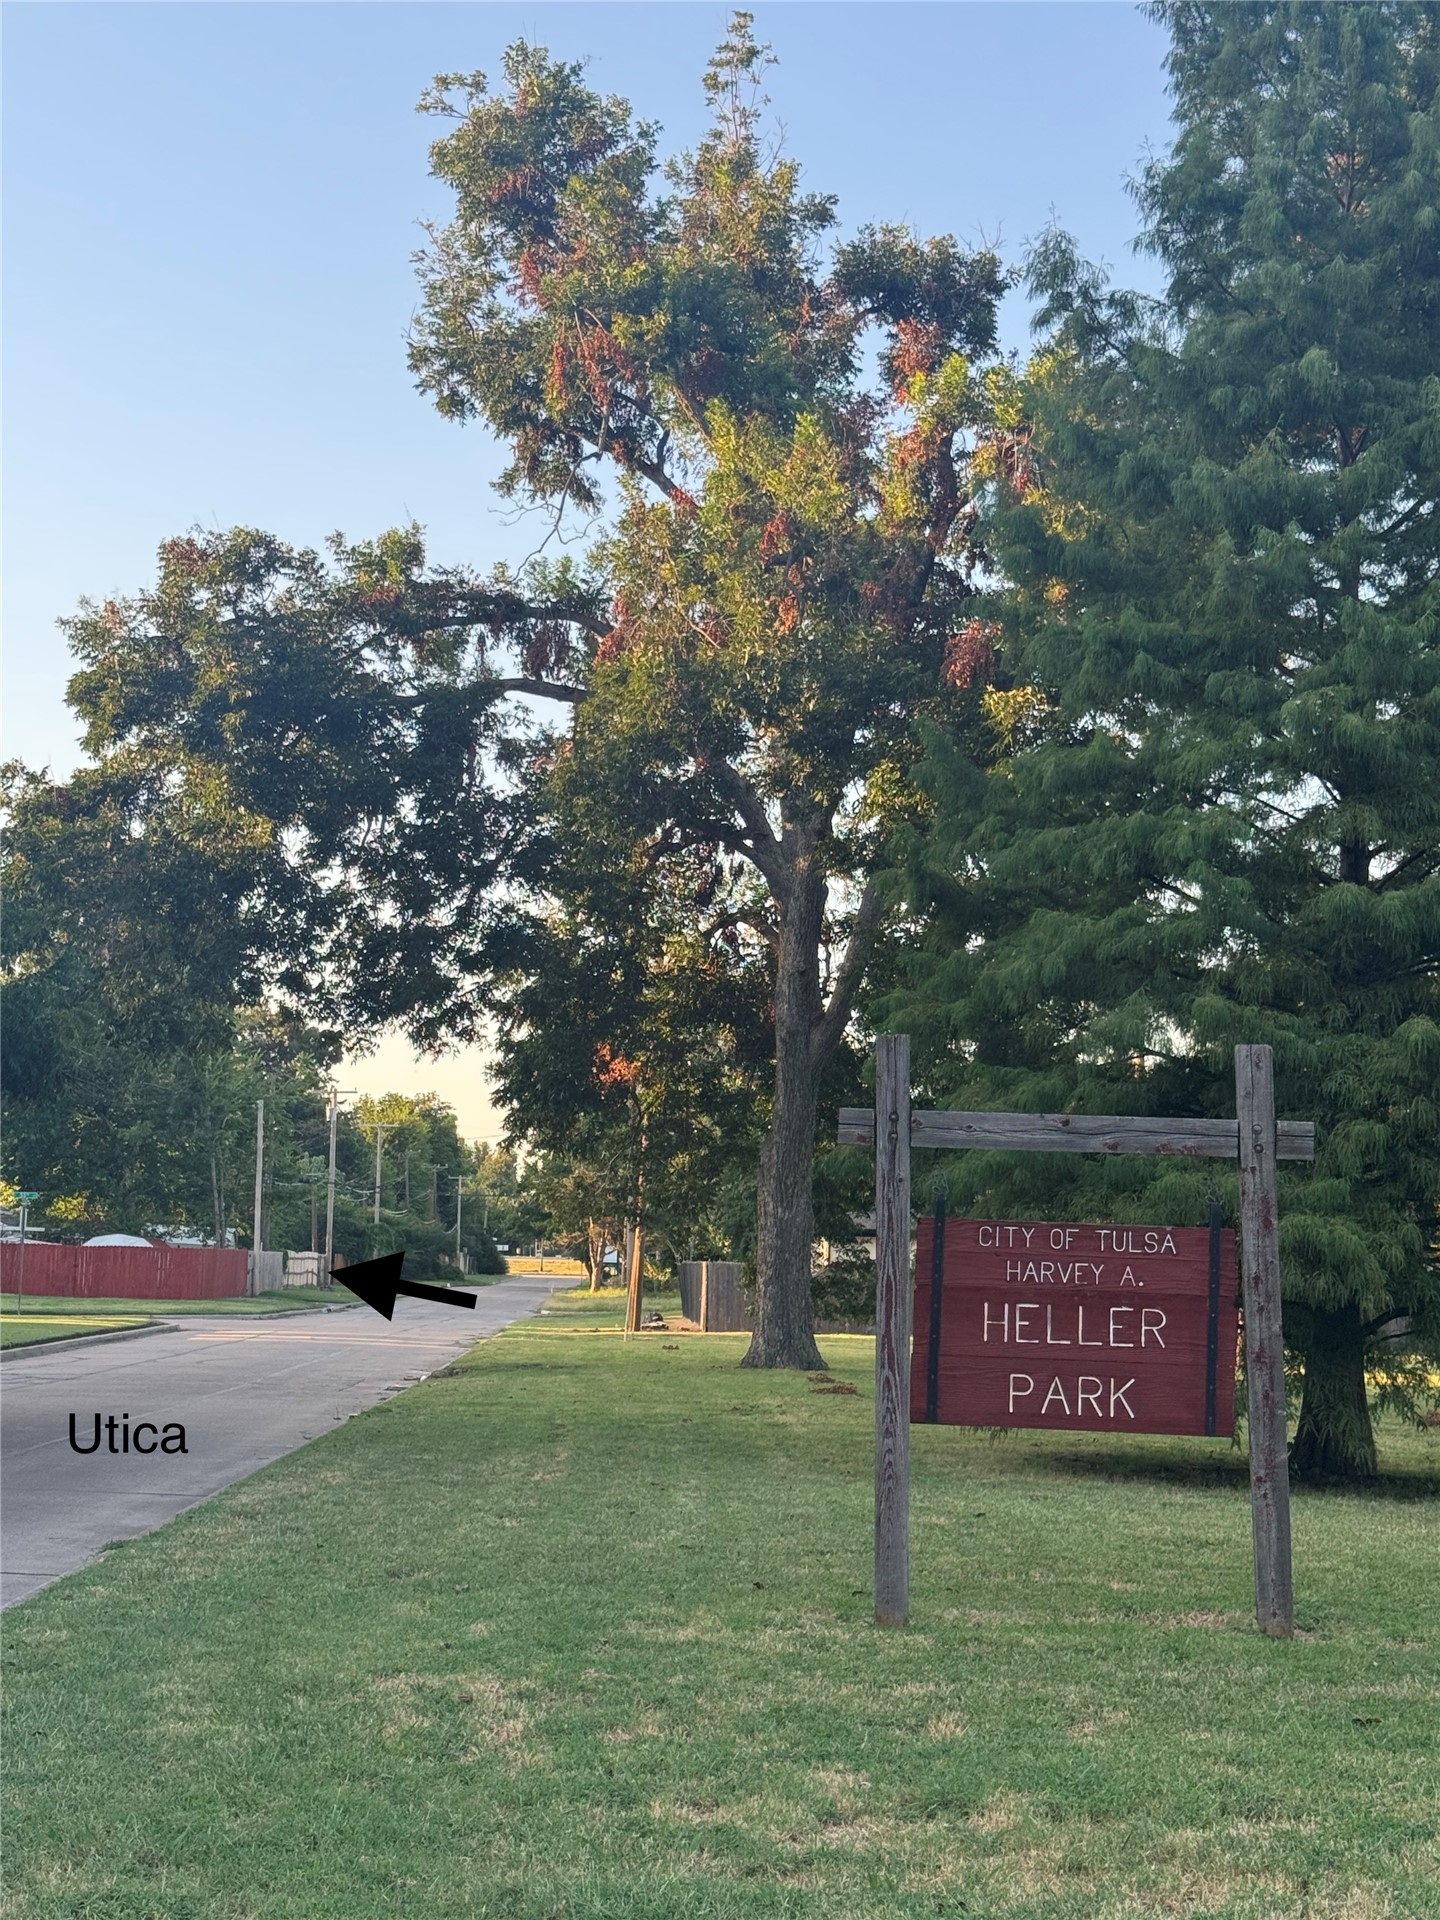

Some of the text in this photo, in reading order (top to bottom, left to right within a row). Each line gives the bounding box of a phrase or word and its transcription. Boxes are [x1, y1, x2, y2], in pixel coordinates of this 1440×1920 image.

[978, 1225, 1177, 1255] CITY OF TULSA
[1006, 1260, 1144, 1287] HARVEY A.
[983, 1302, 1167, 1349] HELLER
[1009, 1373, 1136, 1419] PARK
